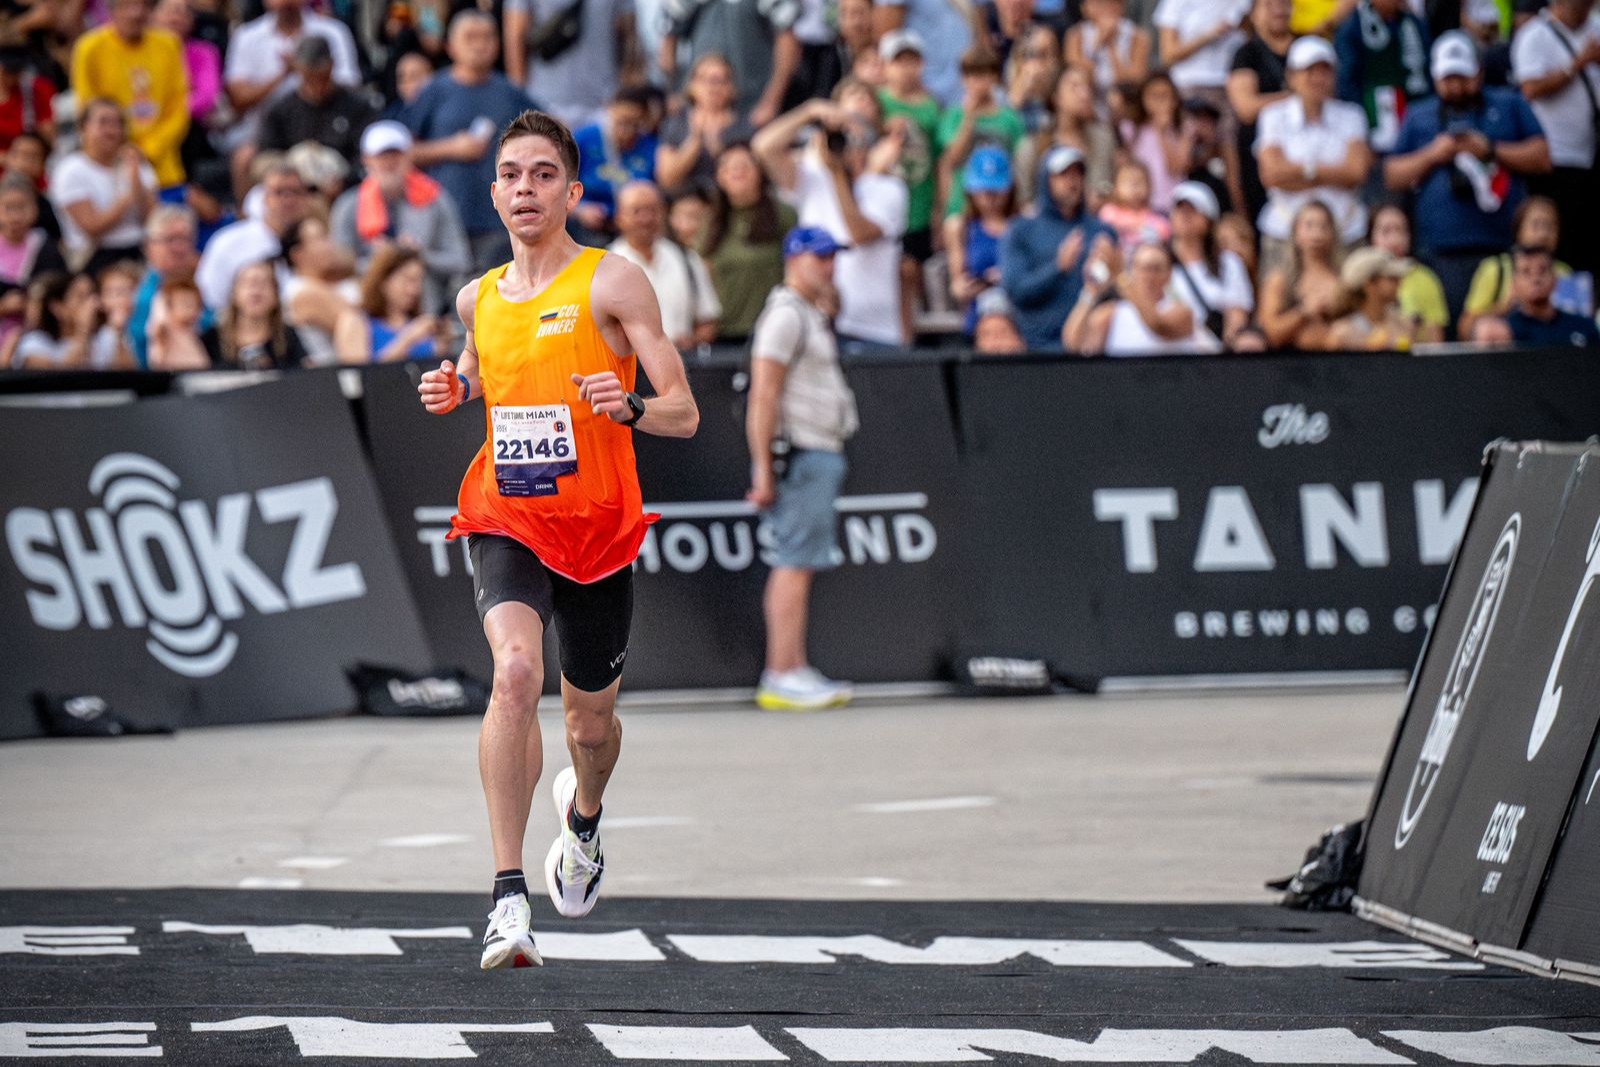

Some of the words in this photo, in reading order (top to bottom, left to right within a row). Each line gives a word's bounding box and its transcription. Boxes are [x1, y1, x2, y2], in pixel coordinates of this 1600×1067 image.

[557, 304, 580, 318] COL
[526, 410, 556, 419] MIAMI
[1257, 403, 1330, 449] The
[497, 437, 569, 460] 22146
[5, 475, 367, 631] SHOKZ
[1174, 607, 1371, 639] BREWING
